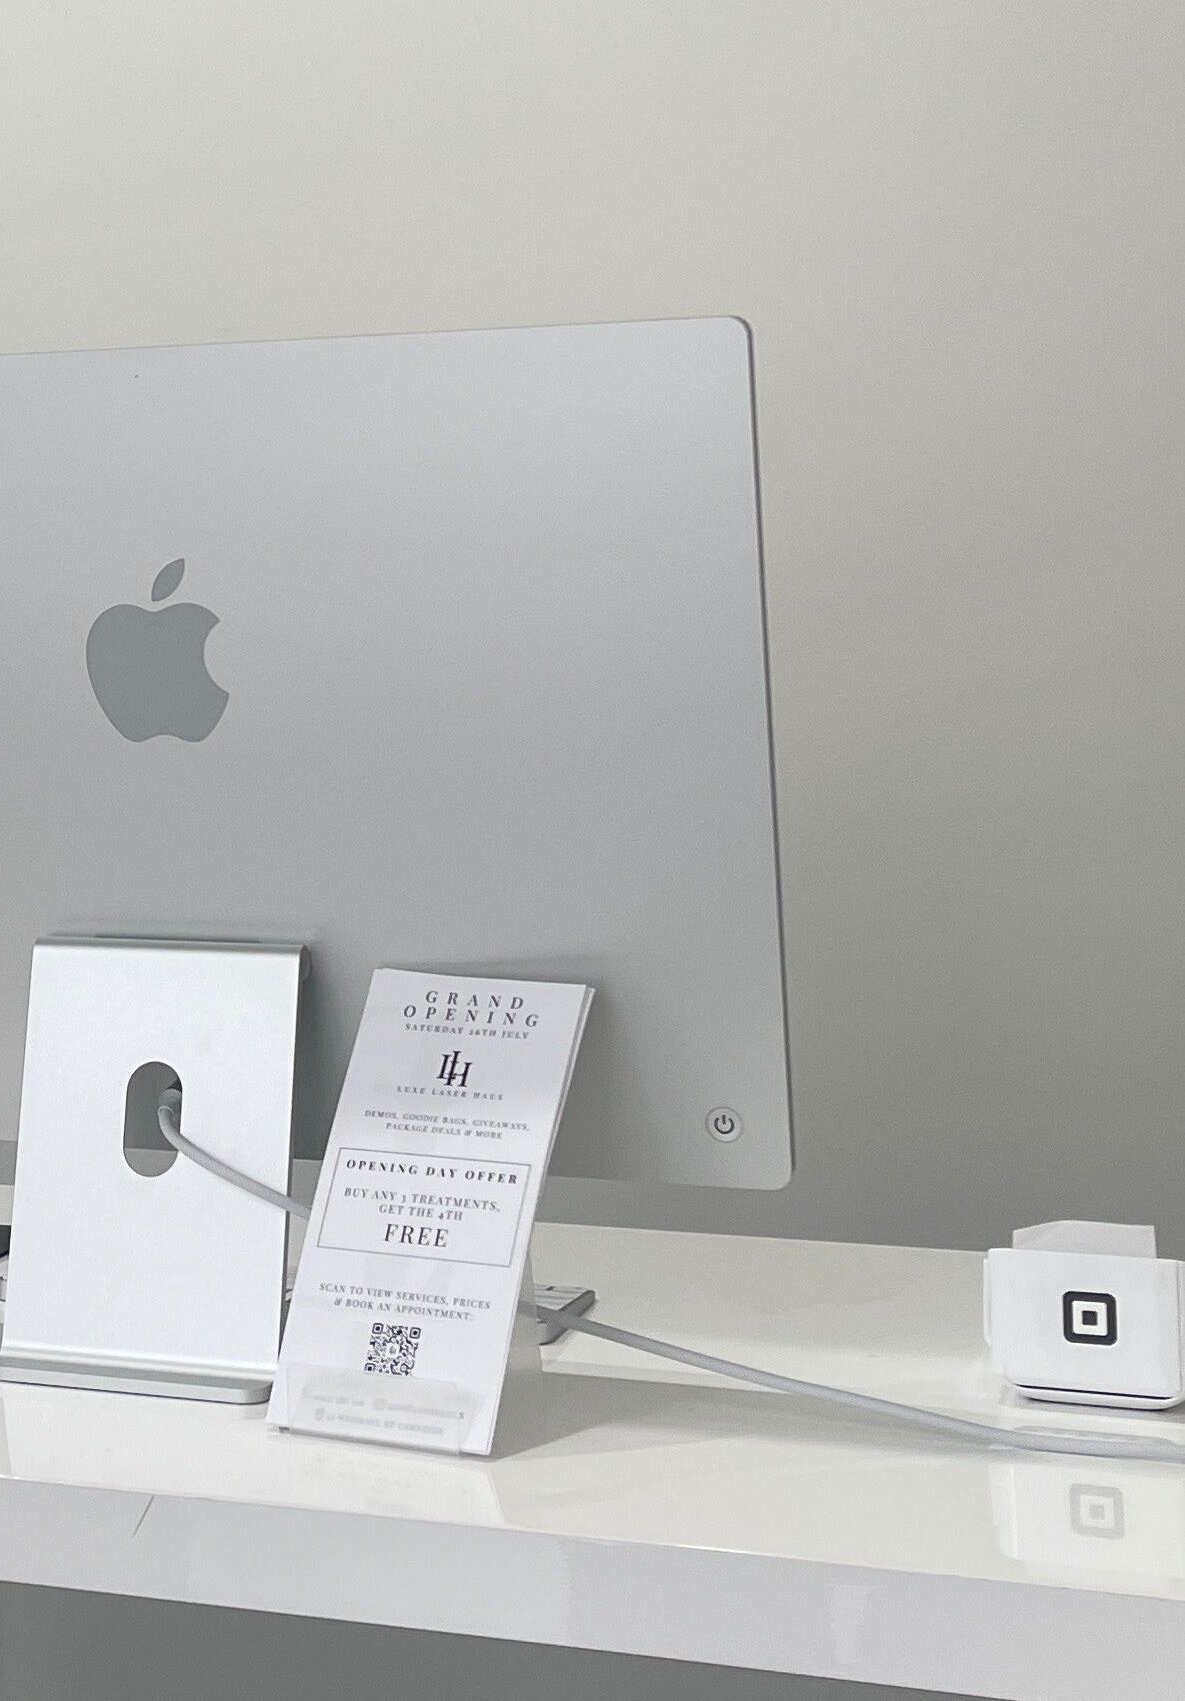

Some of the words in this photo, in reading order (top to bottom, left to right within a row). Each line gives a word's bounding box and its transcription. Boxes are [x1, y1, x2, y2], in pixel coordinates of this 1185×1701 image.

[425, 990, 524, 1009] GRAND
[403, 1005, 539, 1027] OPENING
[405, 1023, 464, 1035] SATURDAY
[501, 1029, 529, 1039] JULY
[397, 1085, 425, 1095] LUXE
[431, 1088, 467, 1098] LASER
[403, 1112, 439, 1123] GOODIE
[385, 1122, 428, 1133] PACKAGE
[431, 1126, 461, 1136] DEALS
[475, 1130, 503, 1139] MORE
[346, 1159, 418, 1175] OPENING
[426, 1166, 458, 1179] DAY
[465, 1170, 517, 1184] OFFER
[344, 1187, 369, 1199] BUY
[372, 1190, 397, 1201] ANY
[411, 1193, 501, 1212] TREATMENTS,
[378, 1204, 404, 1216] GET
[408, 1206, 434, 1218] THE
[437, 1211, 463, 1221] 4TH
[384, 1223, 449, 1248] FREE
[319, 1282, 346, 1294] SCAN
[350, 1286, 364, 1296] TO
[367, 1288, 393, 1298] VIEW
[396, 1291, 449, 1306] SERVICES,
[452, 1297, 491, 1310] PRICES
[334, 1298, 343, 1306] &
[346, 1299, 374, 1311] BOOK
[377, 1303, 392, 1312] AN
[394, 1304, 474, 1321] APPOINTMENT:
